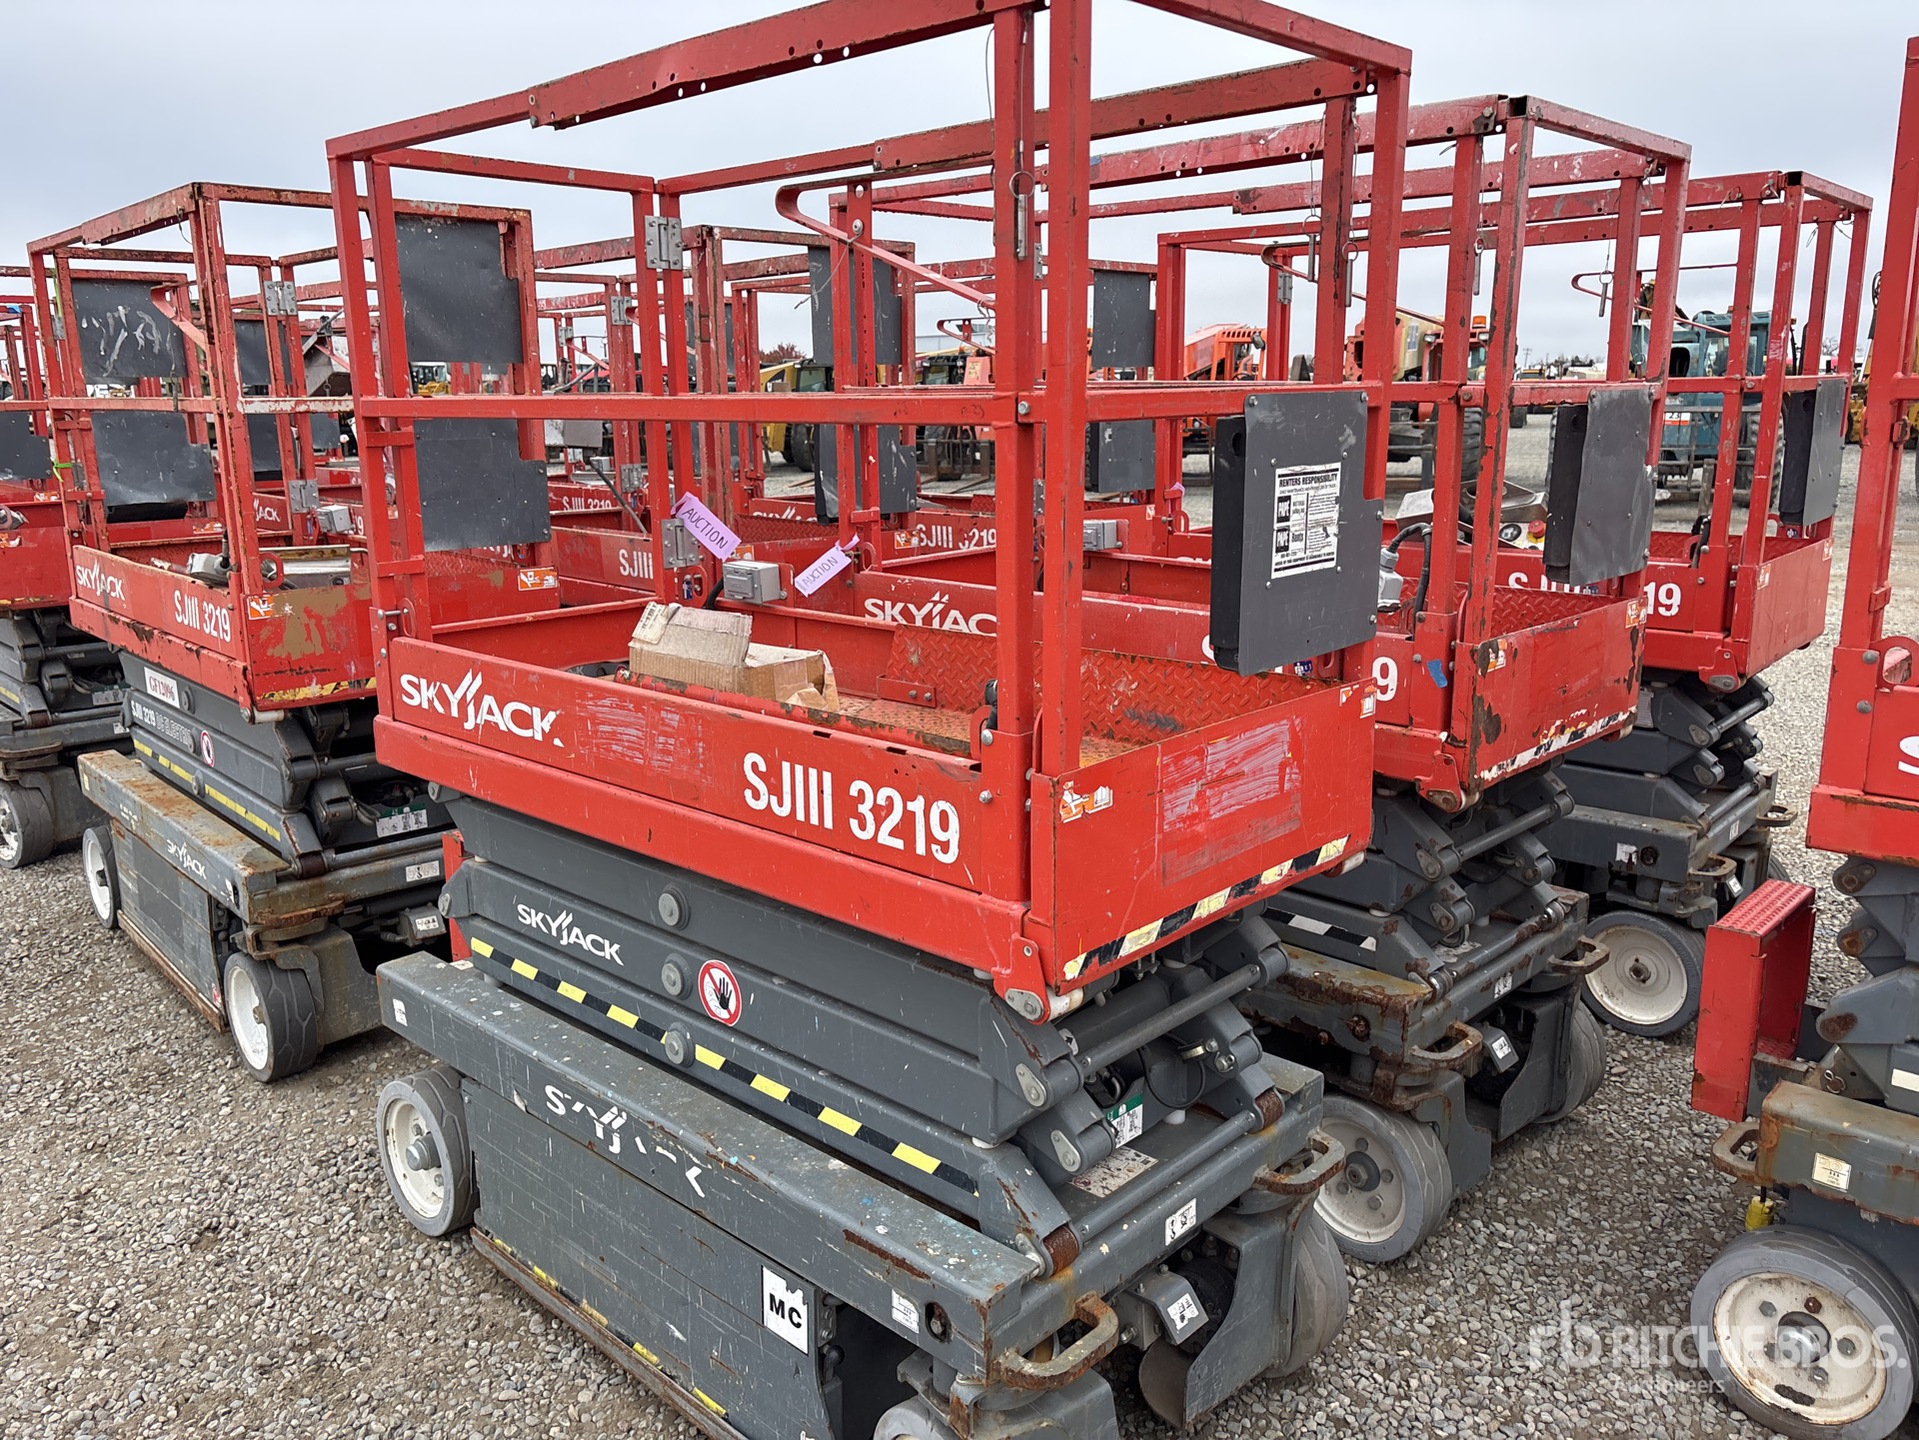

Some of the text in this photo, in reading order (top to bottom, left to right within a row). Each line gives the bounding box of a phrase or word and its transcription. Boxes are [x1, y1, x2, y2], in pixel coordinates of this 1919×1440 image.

[1279, 477, 1301, 488] RENTERS
[1302, 473, 1338, 485] RESPONSIBILITY
[682, 507, 729, 550] AUCTION
[76, 559, 125, 601] SKYJACK
[801, 556, 839, 588] AUCTION
[174, 590, 231, 643] SJIII 3219
[864, 591, 998, 638] SKYJAC
[143, 706, 156, 727] 3219
[400, 668, 565, 748] SKYJACK
[743, 752, 961, 864] SJIII 3219
[517, 903, 625, 967] SKYJACK
[769, 1292, 803, 1330] MC
